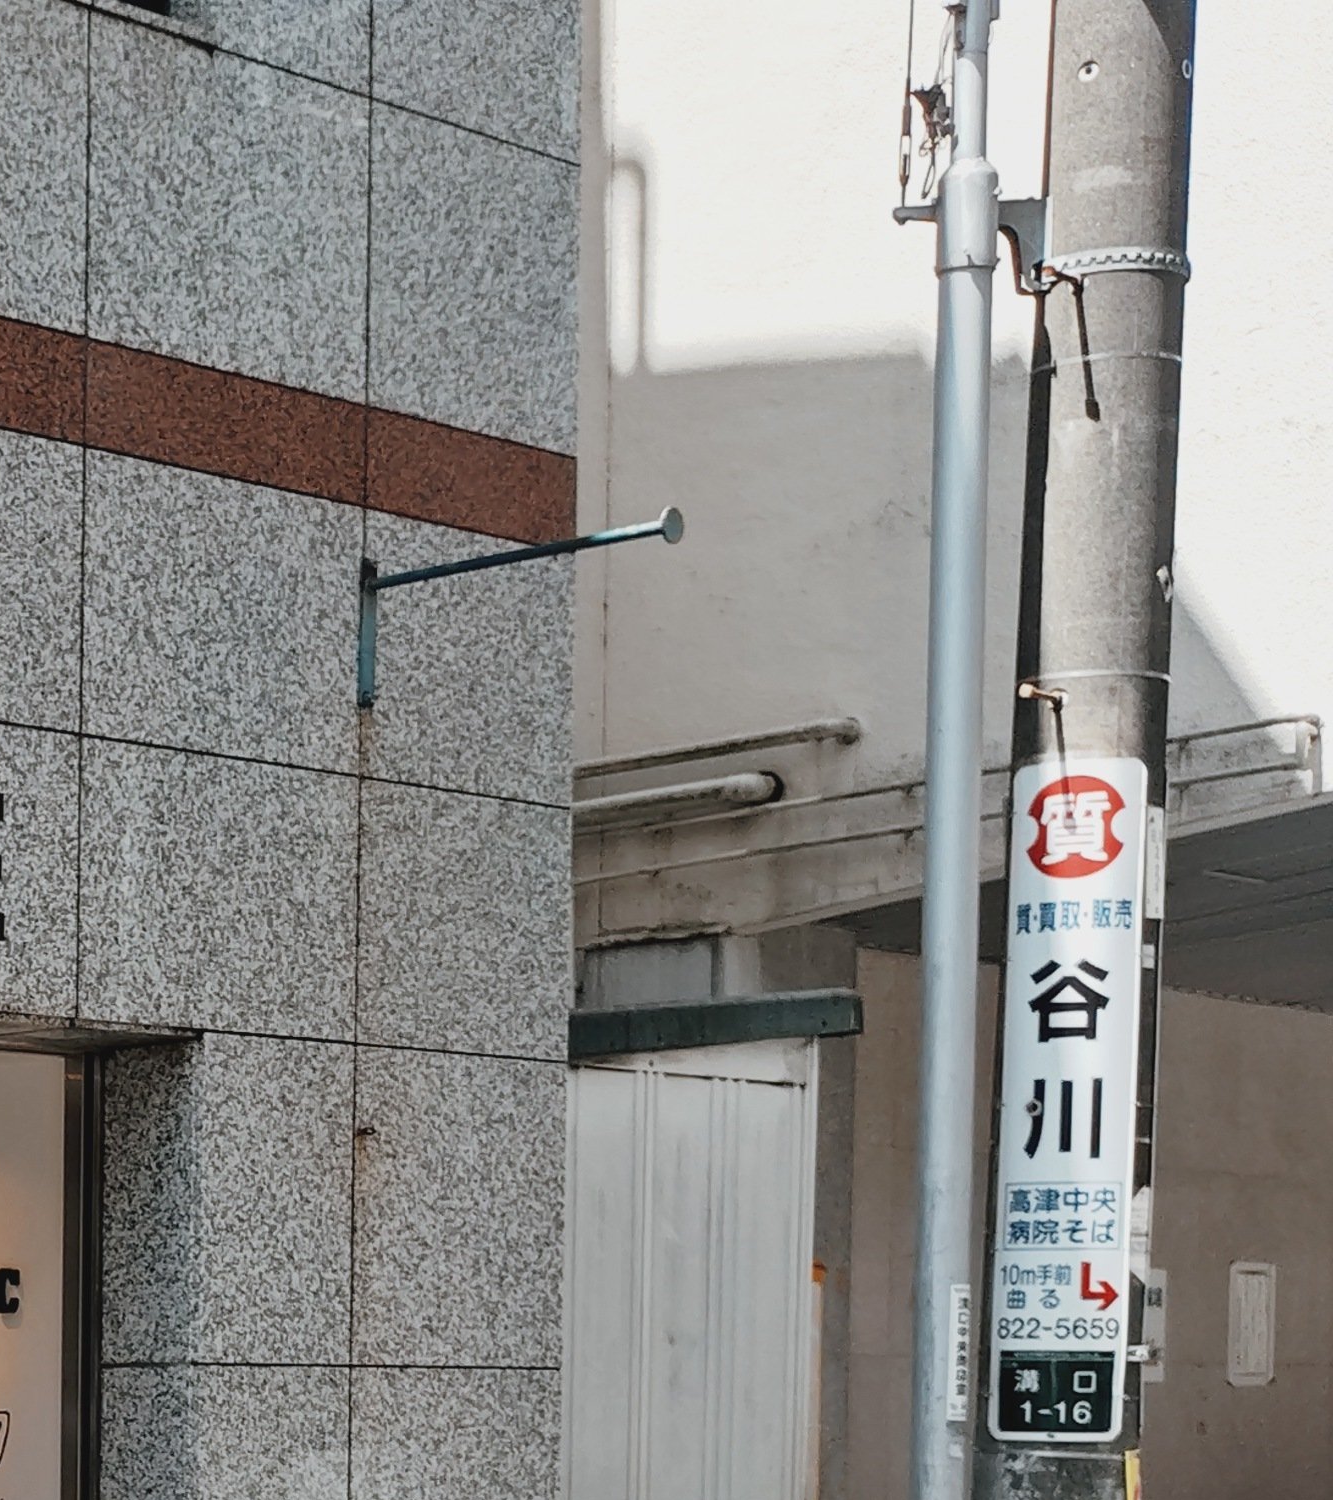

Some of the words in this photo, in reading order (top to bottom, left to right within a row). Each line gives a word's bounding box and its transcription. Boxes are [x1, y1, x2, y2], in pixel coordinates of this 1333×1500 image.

[1040, 790, 1112, 866] 質
[1008, 1187, 1117, 1214] 高津中央
[1007, 1218, 1116, 1245] 病院そば
[1000, 1263, 1072, 1287] 10m手前
[1006, 1288, 1061, 1310] 曲る
[996, 1316, 1120, 1340] 822-5659
[1019, 1400, 1093, 1425] 1-16
